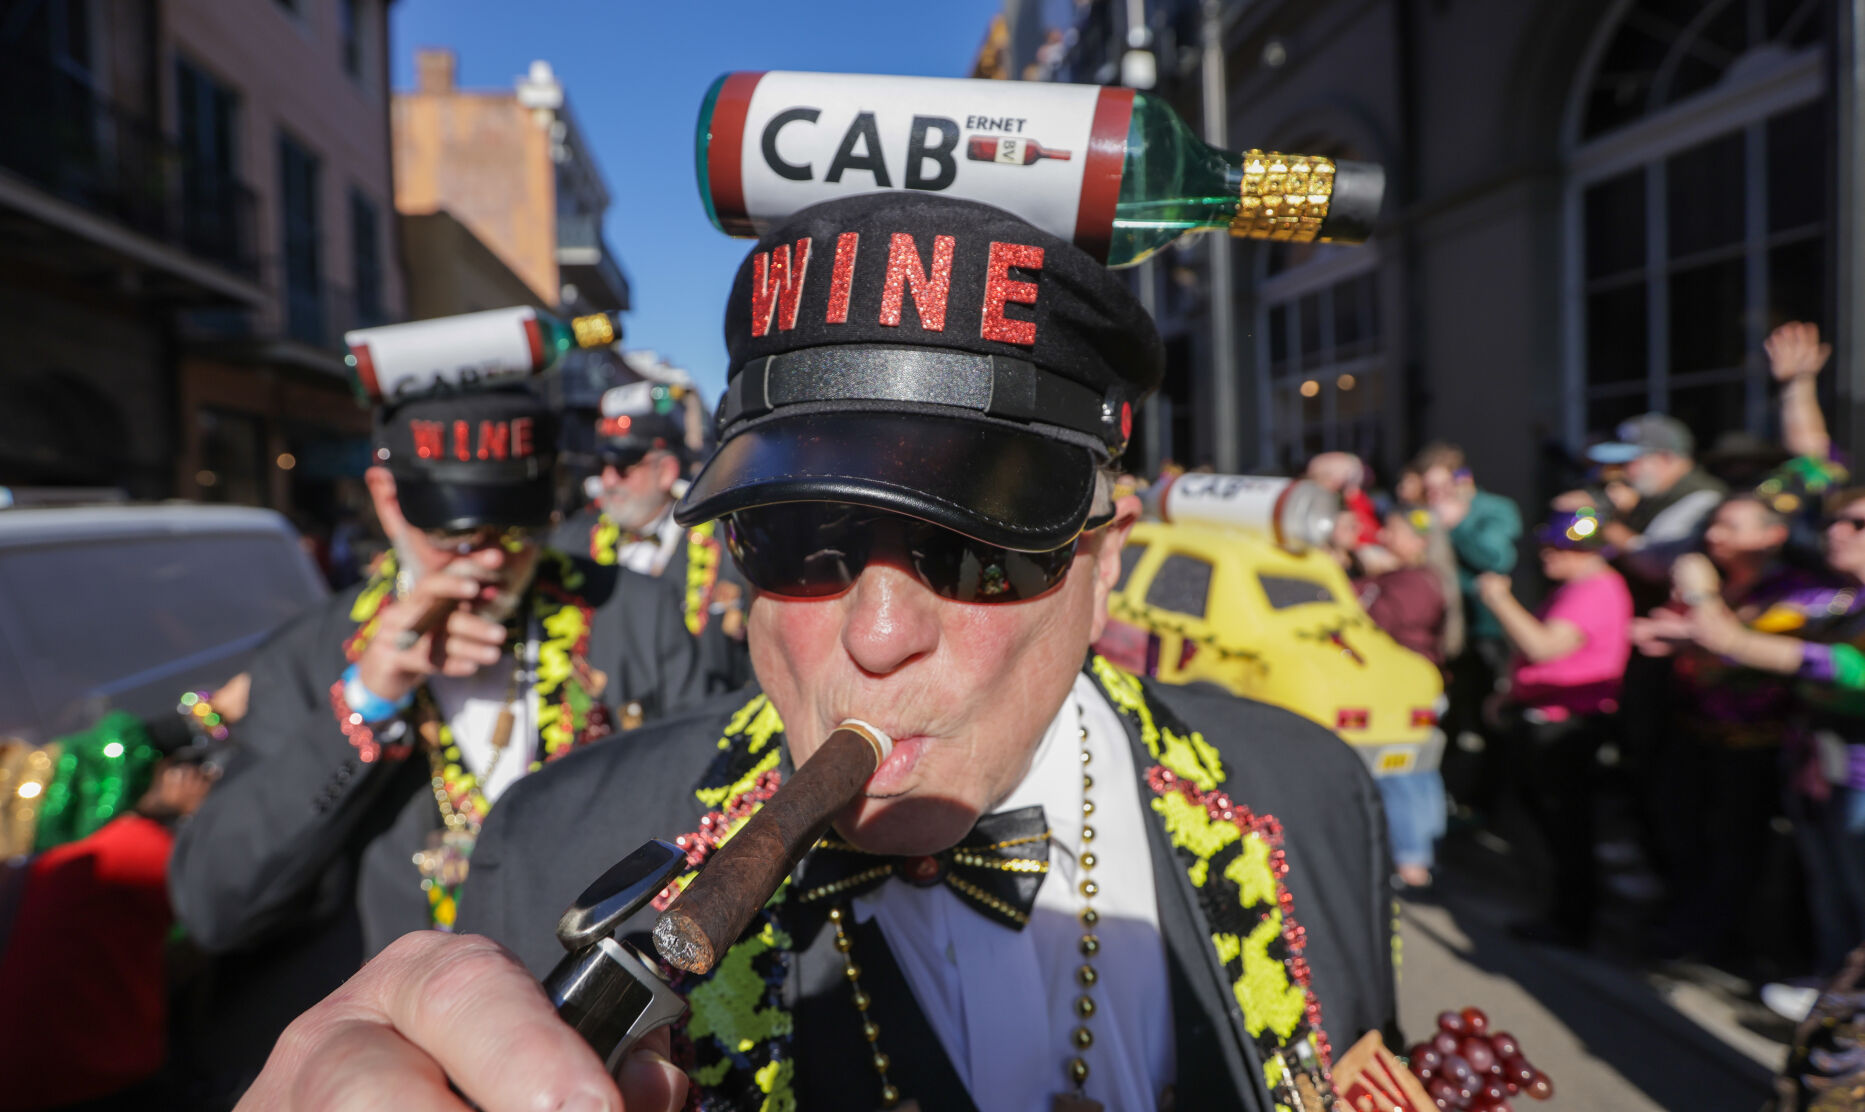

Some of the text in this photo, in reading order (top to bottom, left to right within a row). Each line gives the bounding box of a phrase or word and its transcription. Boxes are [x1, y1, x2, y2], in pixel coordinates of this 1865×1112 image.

[761, 107, 1027, 191] CAB ERNET
[751, 231, 1045, 345] WINE
[410, 417, 534, 461] WINE
